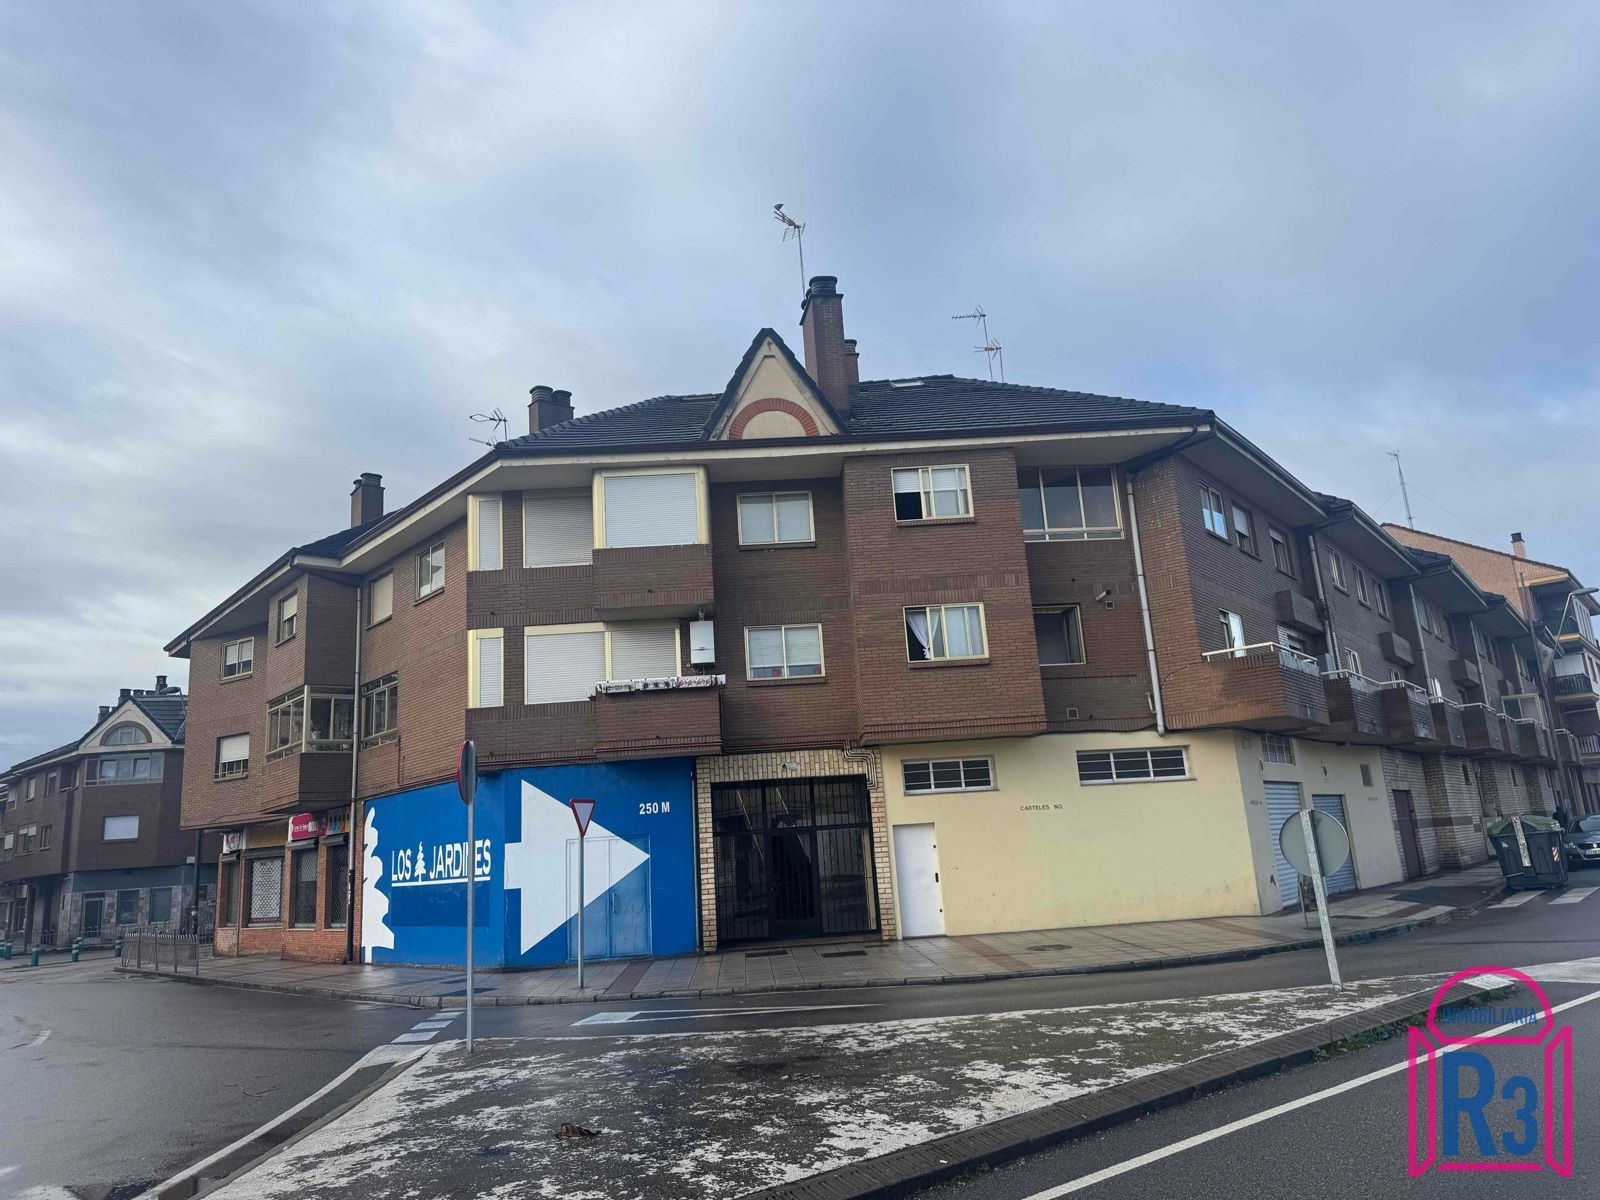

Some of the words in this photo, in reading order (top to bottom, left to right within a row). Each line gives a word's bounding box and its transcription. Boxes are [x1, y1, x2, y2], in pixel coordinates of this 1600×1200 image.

[639, 802, 659, 815] 250
[661, 801, 670, 814] M
[391, 848, 412, 881] LOS
